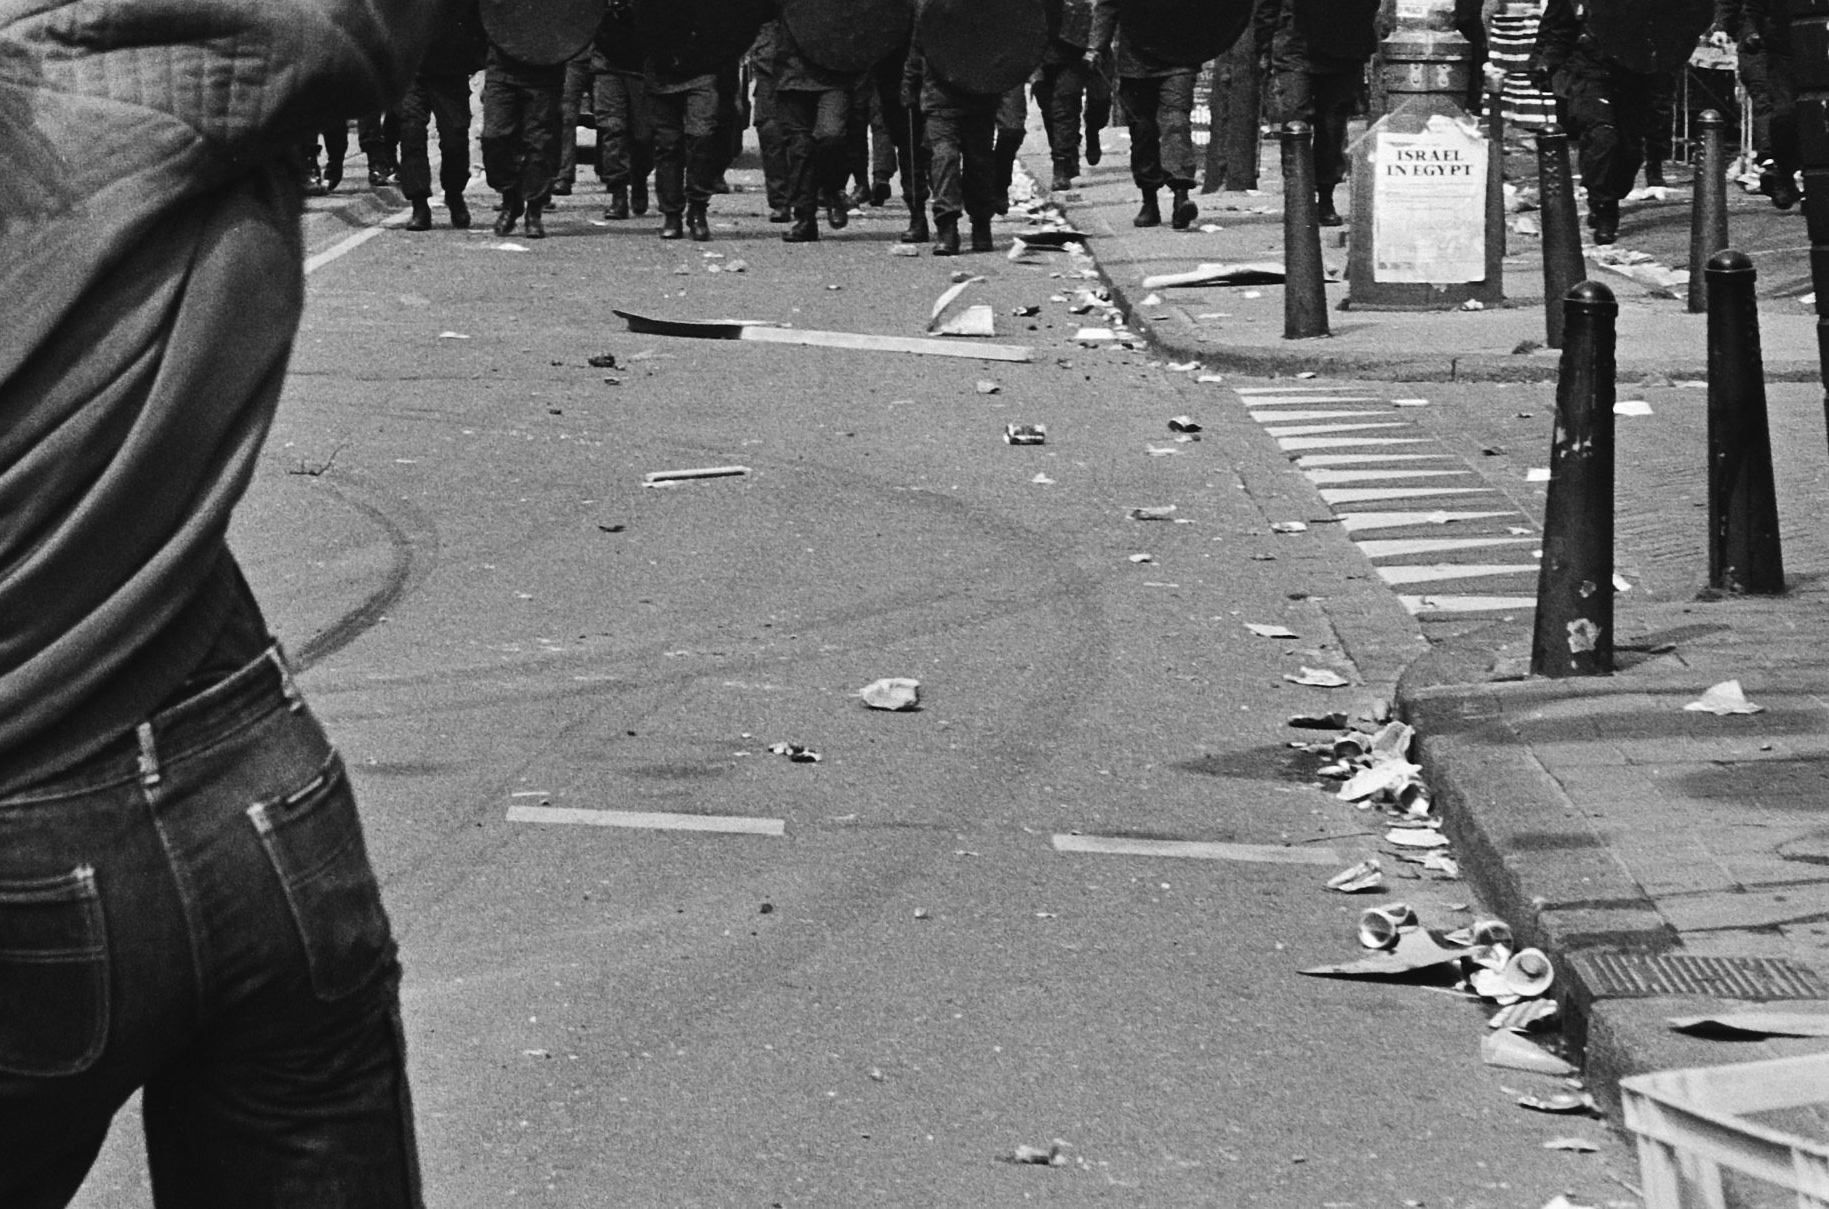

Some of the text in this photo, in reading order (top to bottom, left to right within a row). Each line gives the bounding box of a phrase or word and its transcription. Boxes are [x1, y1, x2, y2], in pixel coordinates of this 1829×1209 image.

[1397, 149, 1464, 162] ISRAEL
[1386, 164, 1474, 177] IN EGYPT
